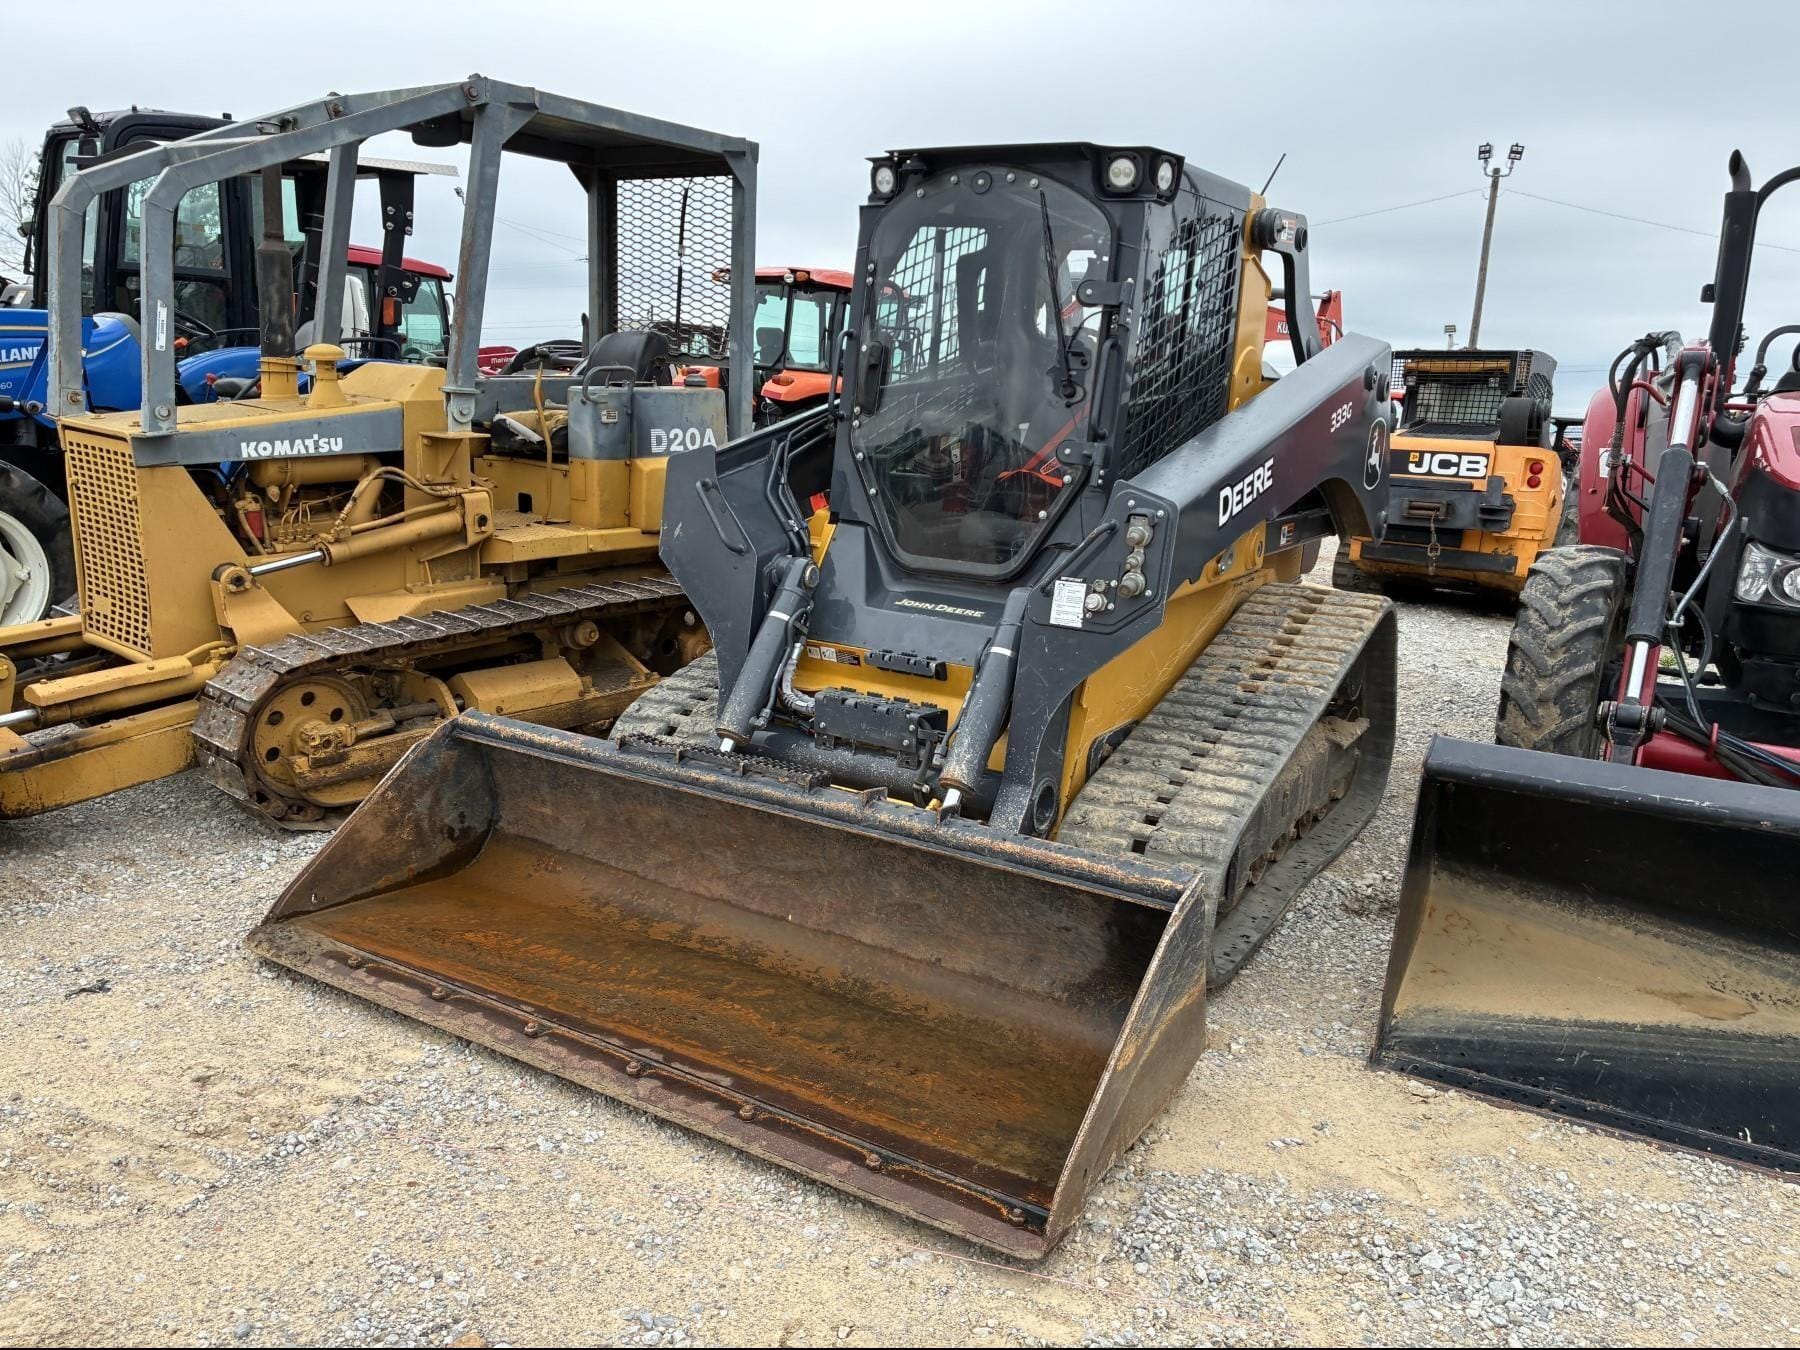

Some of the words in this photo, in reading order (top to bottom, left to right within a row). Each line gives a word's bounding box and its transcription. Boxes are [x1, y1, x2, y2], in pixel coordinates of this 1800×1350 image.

[1277, 321, 1290, 334] KU
[0, 346, 40, 362] LAN
[1330, 402, 1353, 433] 333G
[240, 434, 343, 458] KOMATSU
[650, 427, 718, 453] D20A
[1408, 452, 1488, 477] JCB
[1218, 457, 1274, 528] DEERE
[894, 598, 934, 610] JOHN
[934, 603, 985, 618] DEERE
